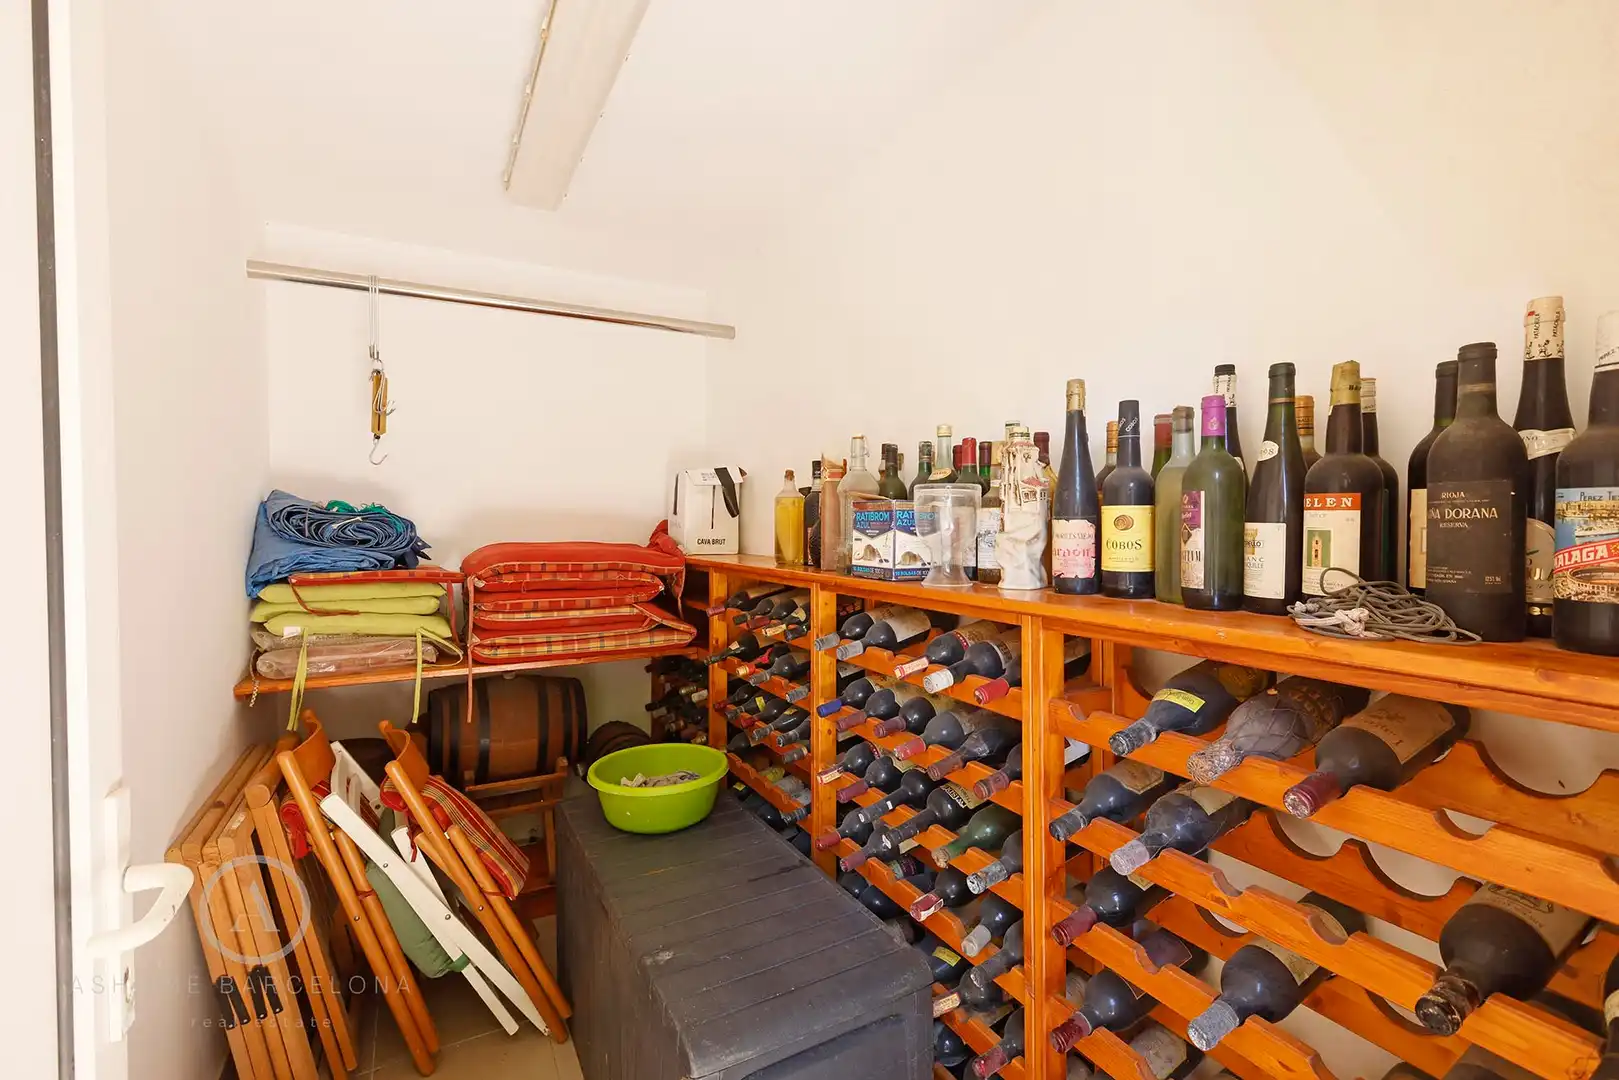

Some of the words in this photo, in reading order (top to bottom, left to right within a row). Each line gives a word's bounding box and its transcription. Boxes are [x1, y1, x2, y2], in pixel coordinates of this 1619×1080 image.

[1441, 491, 1466, 499] RIOJA
[1579, 491, 1604, 502] PEREZ
[1304, 497, 1353, 508] ELEN
[856, 511, 890, 522] RATIBROM
[1445, 507, 1498, 519] DORANA
[856, 521, 870, 529] AZUL
[696, 538, 711, 546] CAVA
[711, 538, 726, 546] BRUT
[1106, 538, 1142, 551] COBOS
